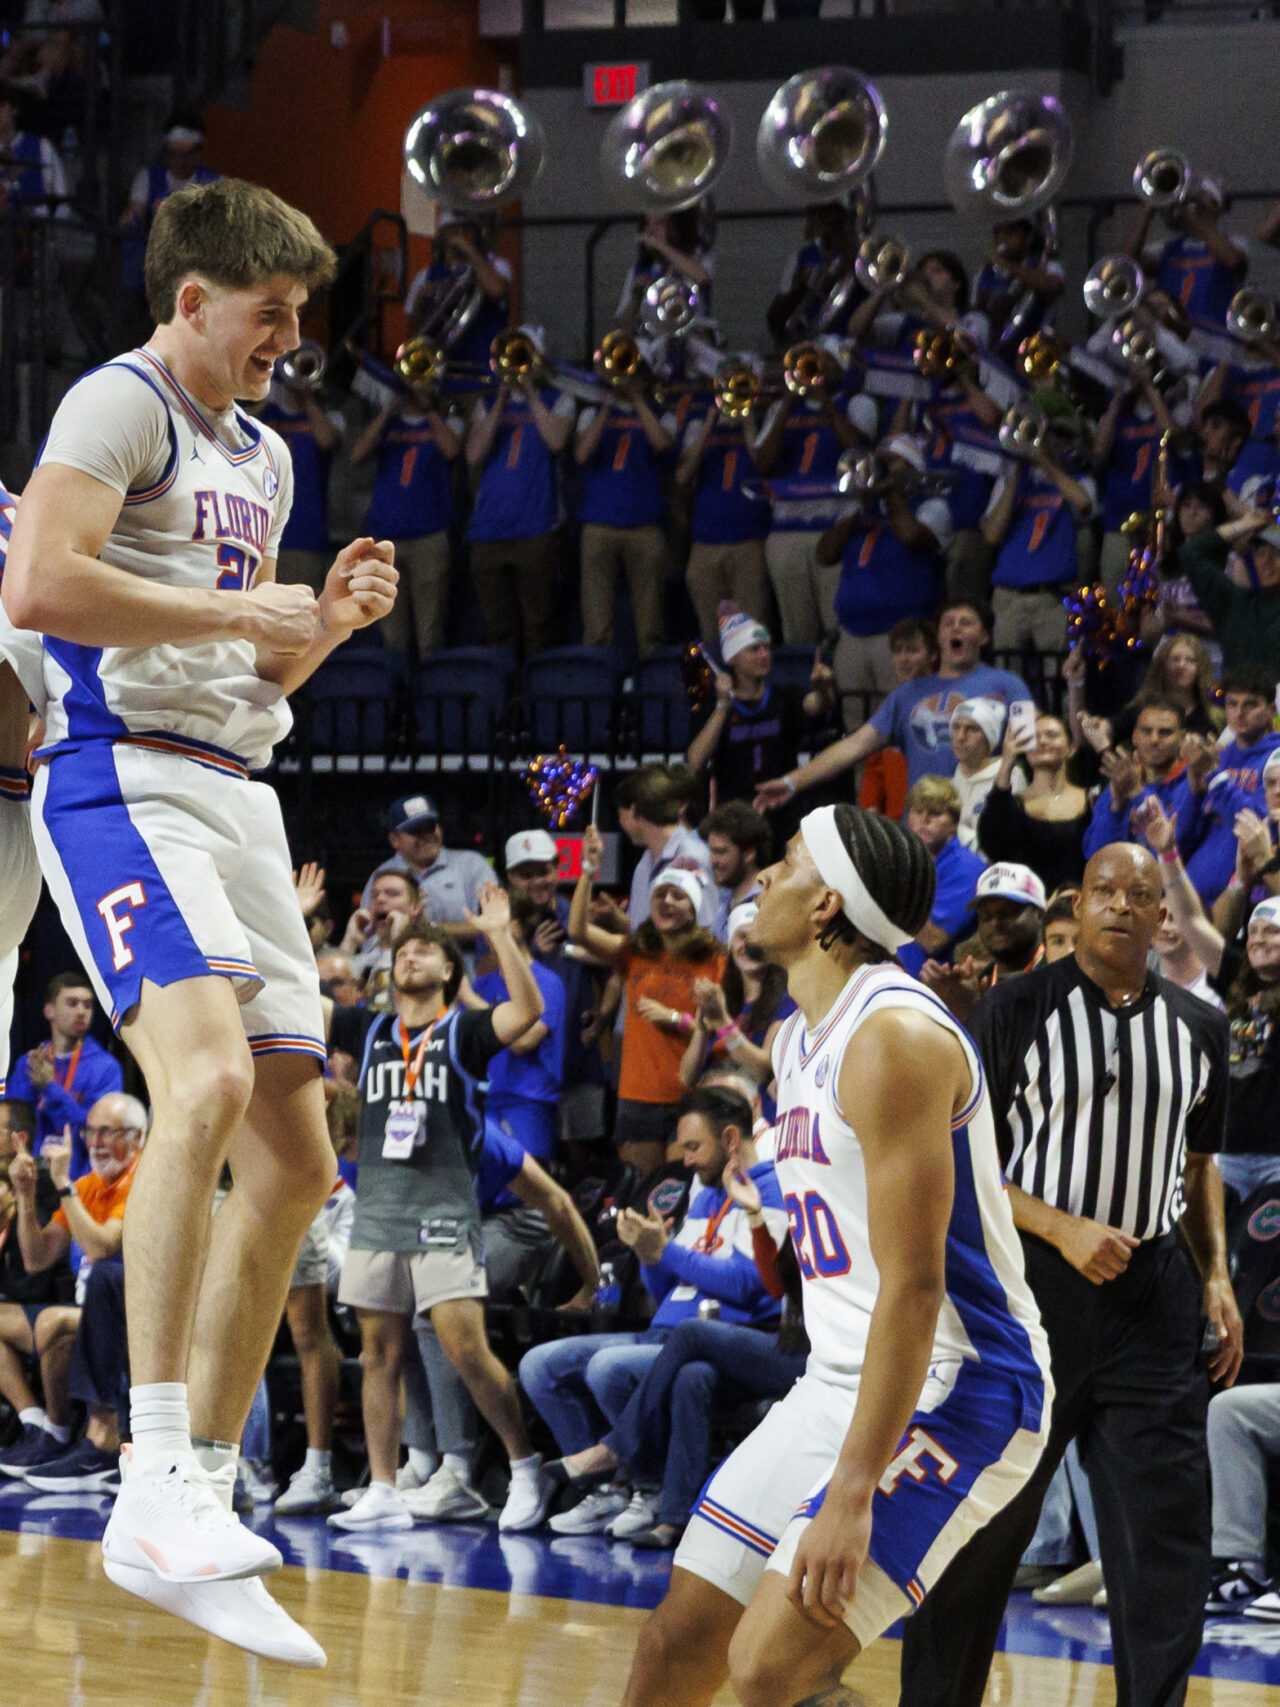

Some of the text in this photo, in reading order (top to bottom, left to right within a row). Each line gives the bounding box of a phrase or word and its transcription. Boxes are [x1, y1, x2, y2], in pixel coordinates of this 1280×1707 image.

[594, 64, 638, 105] EXIT
[191, 490, 274, 555] FLORID
[96, 880, 147, 973] F
[366, 1059, 449, 1104] UTAH
[784, 1189, 852, 1281] 20
[877, 1424, 961, 1497] F
